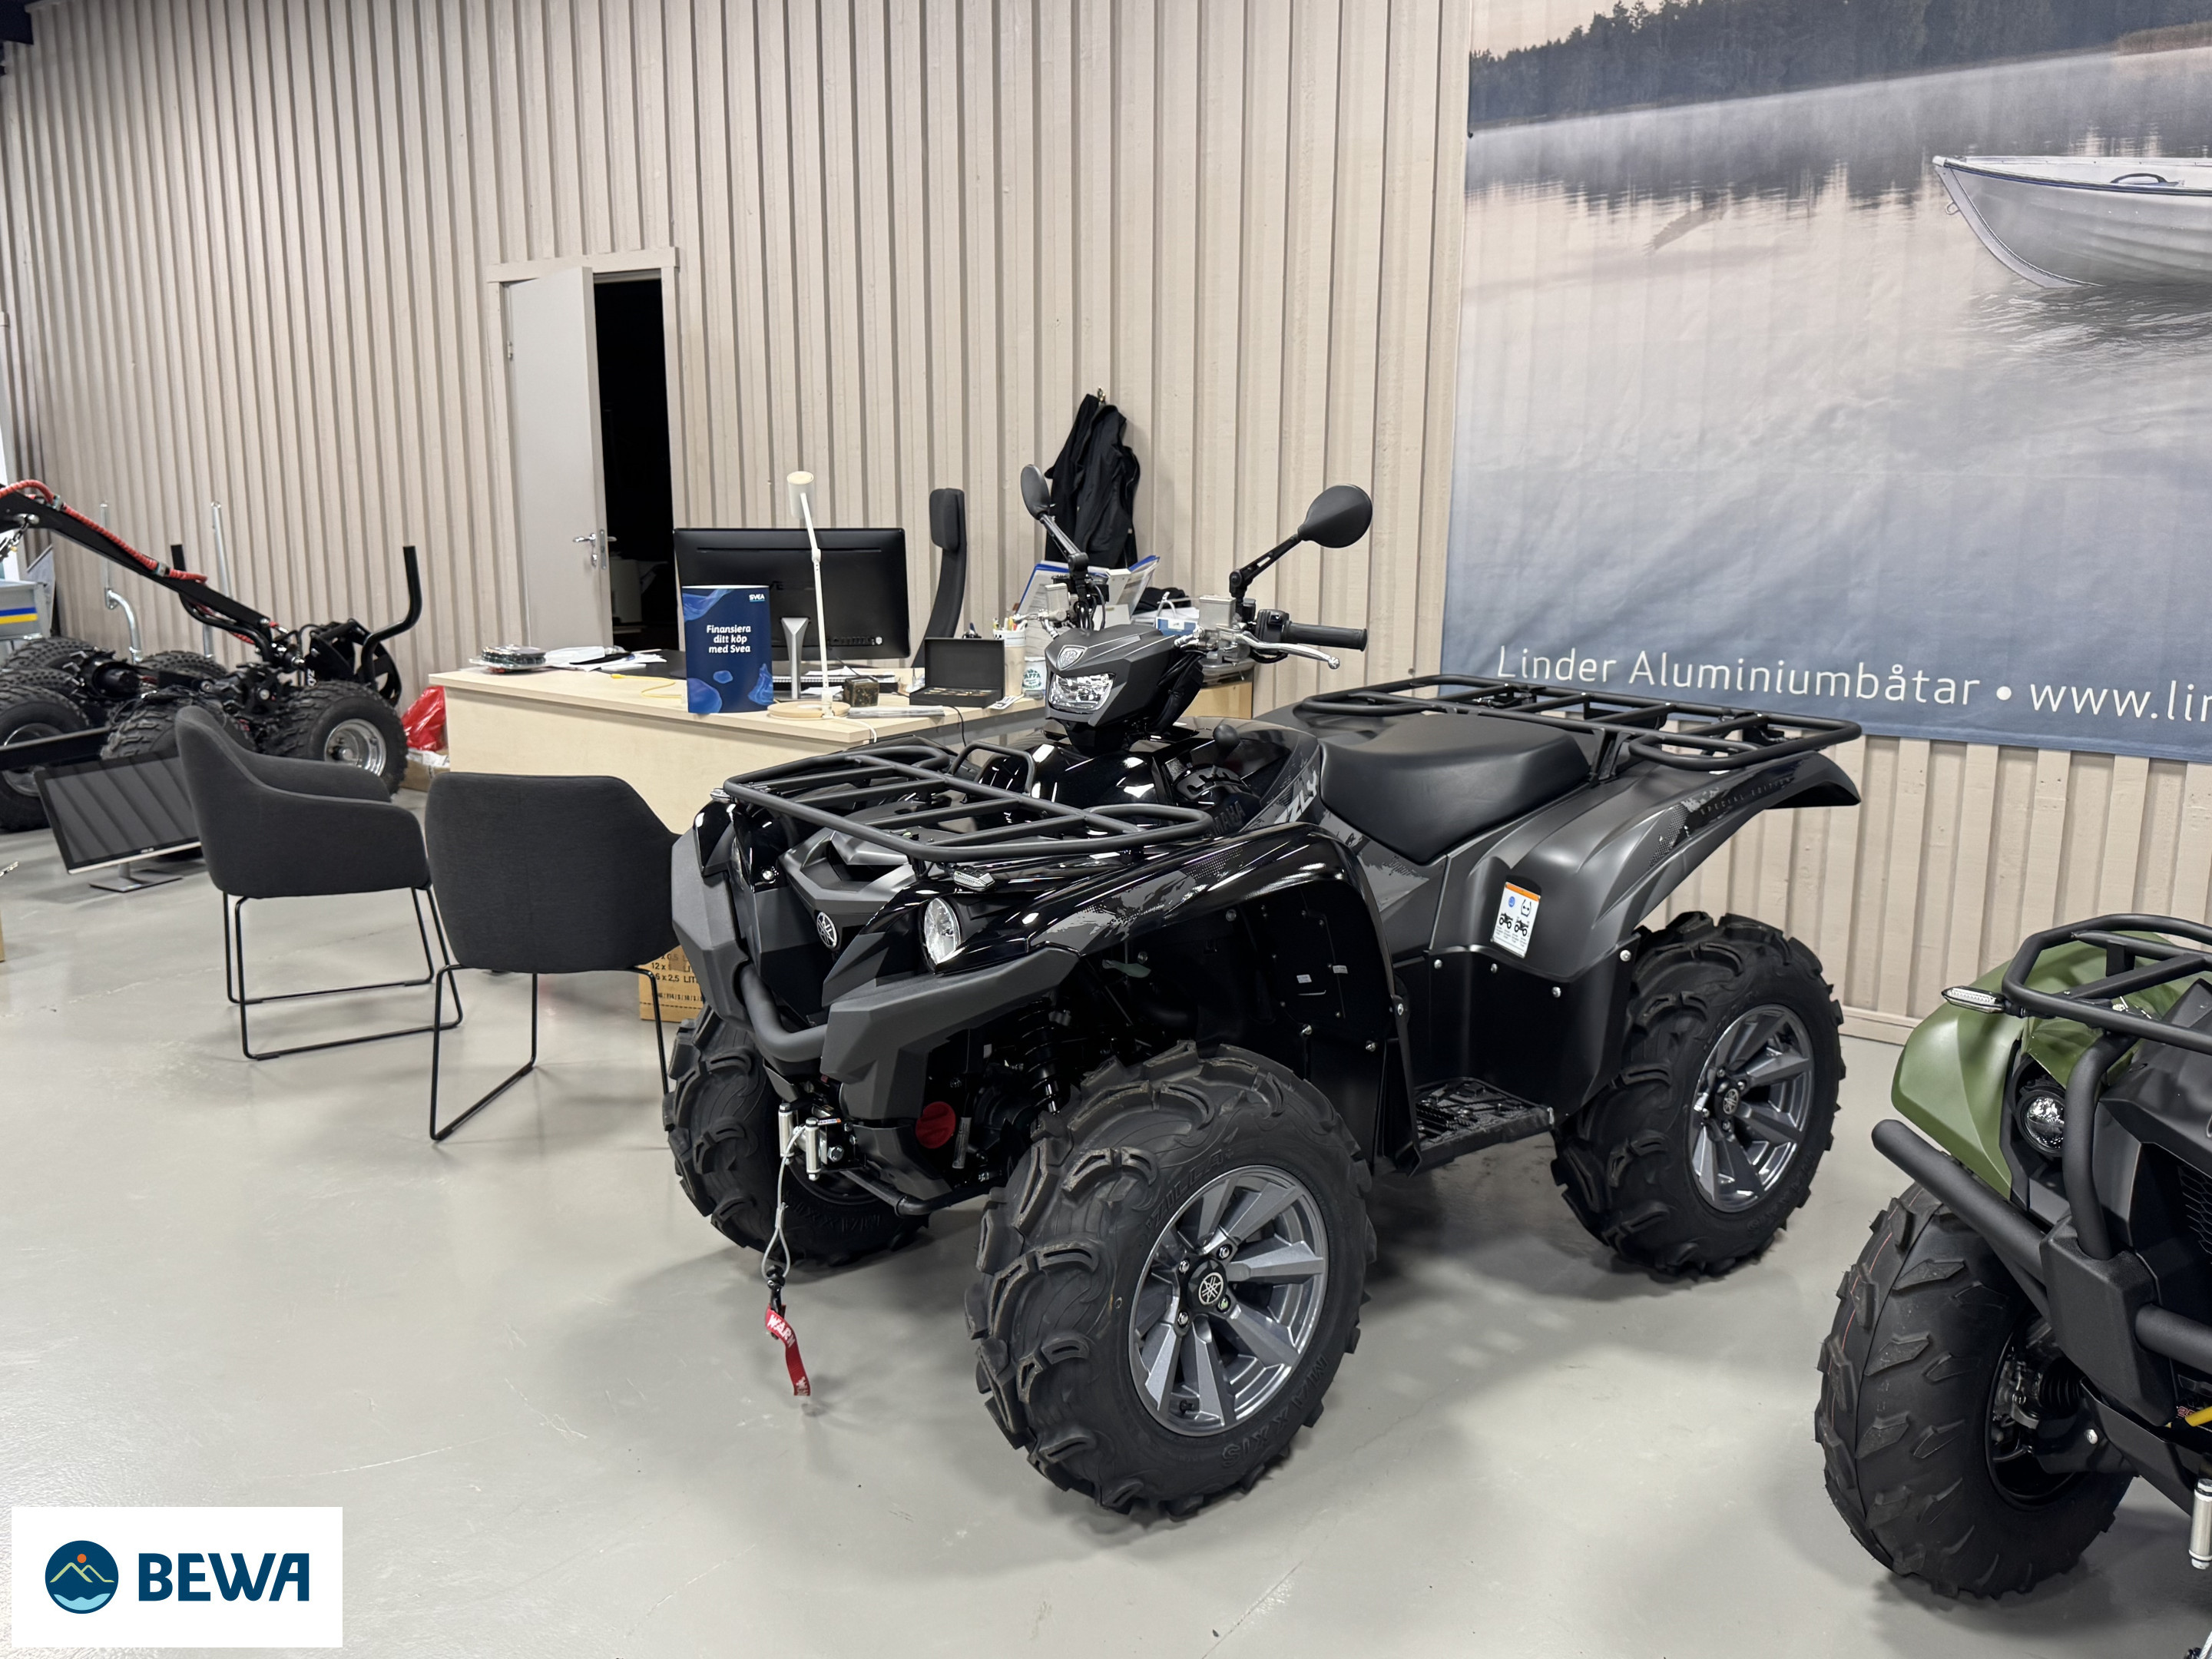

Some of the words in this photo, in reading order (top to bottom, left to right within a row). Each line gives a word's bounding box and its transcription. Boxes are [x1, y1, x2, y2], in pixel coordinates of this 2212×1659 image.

[707, 624, 751, 634] Finansiera
[714, 634, 729, 644] ditt
[730, 634, 747, 644] köp
[708, 644, 729, 654] med
[730, 645, 751, 654] Svea
[1498, 645, 1617, 682] Linder
[1628, 650, 1981, 705] Aluminiumbåtar
[767, 1314, 796, 1349] WARN
